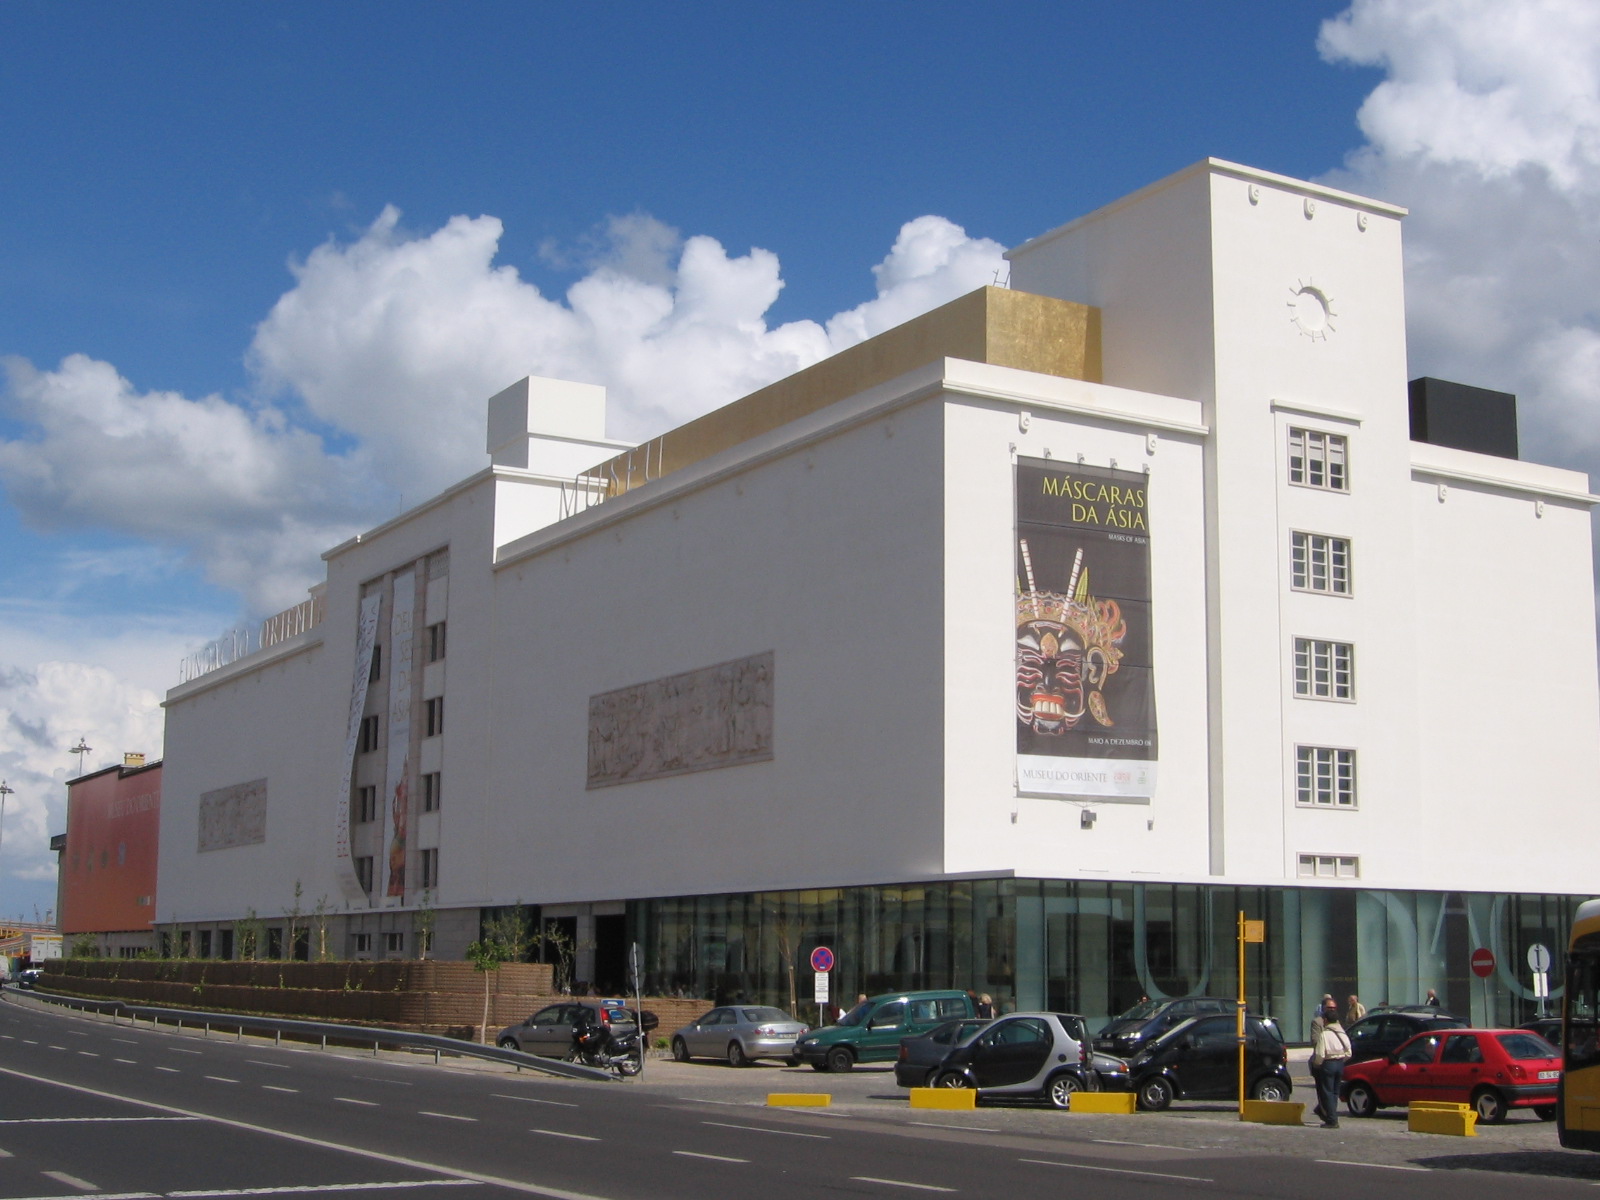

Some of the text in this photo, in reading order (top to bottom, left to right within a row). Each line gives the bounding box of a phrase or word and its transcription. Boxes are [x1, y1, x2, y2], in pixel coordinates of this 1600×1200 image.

[1042, 475, 1145, 508] MÁSCARAS
[1072, 503, 1146, 531] DA ÁSIA
[1022, 768, 1054, 780] MUSEU
[1055, 770, 1070, 782] DO
[1070, 770, 1107, 784] ORIENTE
